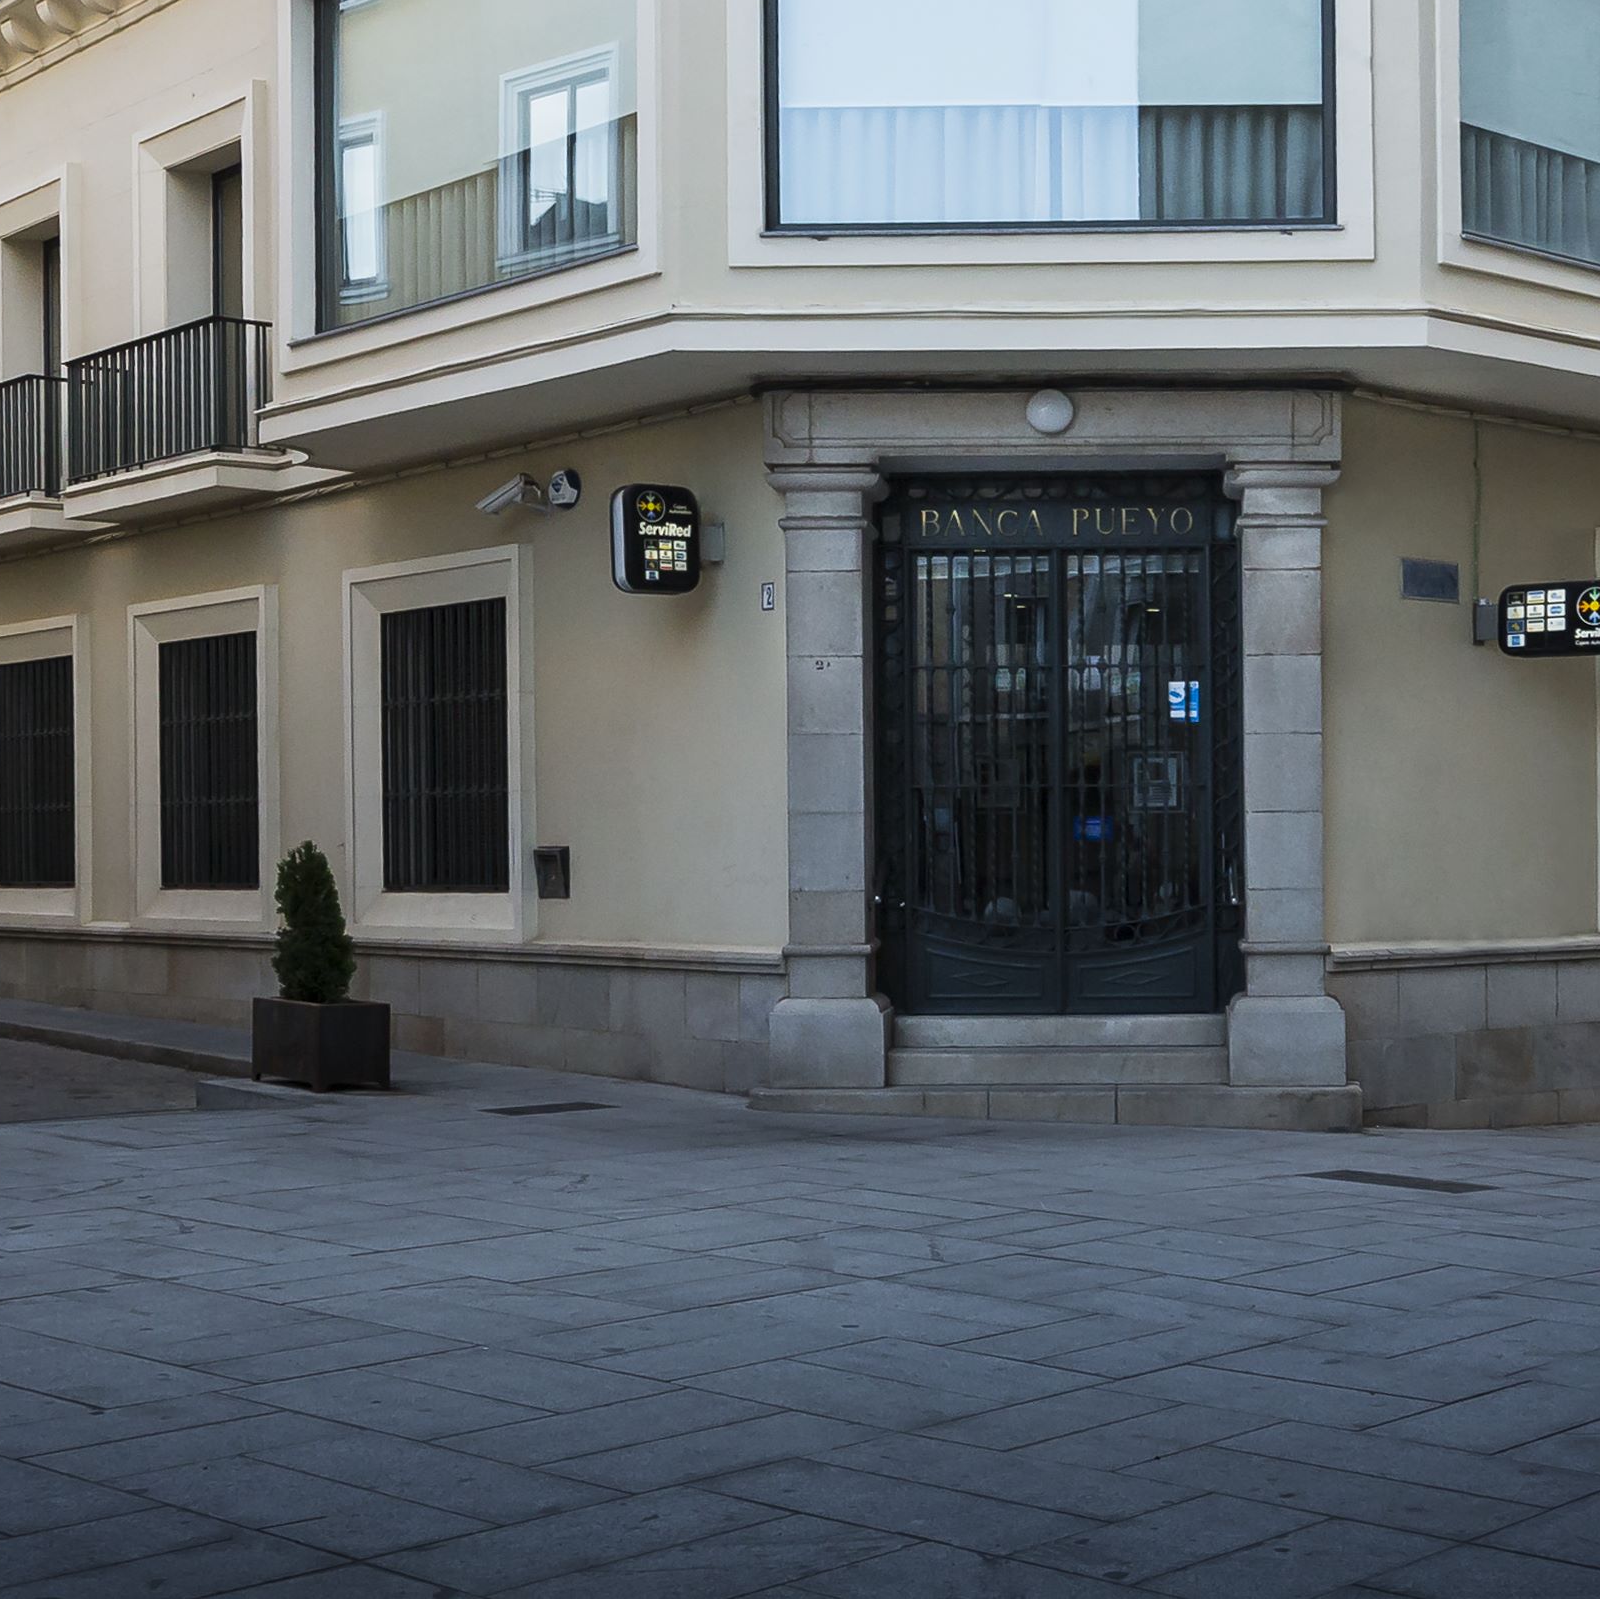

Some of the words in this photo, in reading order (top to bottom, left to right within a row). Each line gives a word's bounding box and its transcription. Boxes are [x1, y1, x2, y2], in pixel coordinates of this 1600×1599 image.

[638, 521, 692, 538] ServiRed
[919, 508, 1044, 538] BANCA
[1071, 507, 1194, 537] PUEYO
[766, 586, 772, 606] 2
